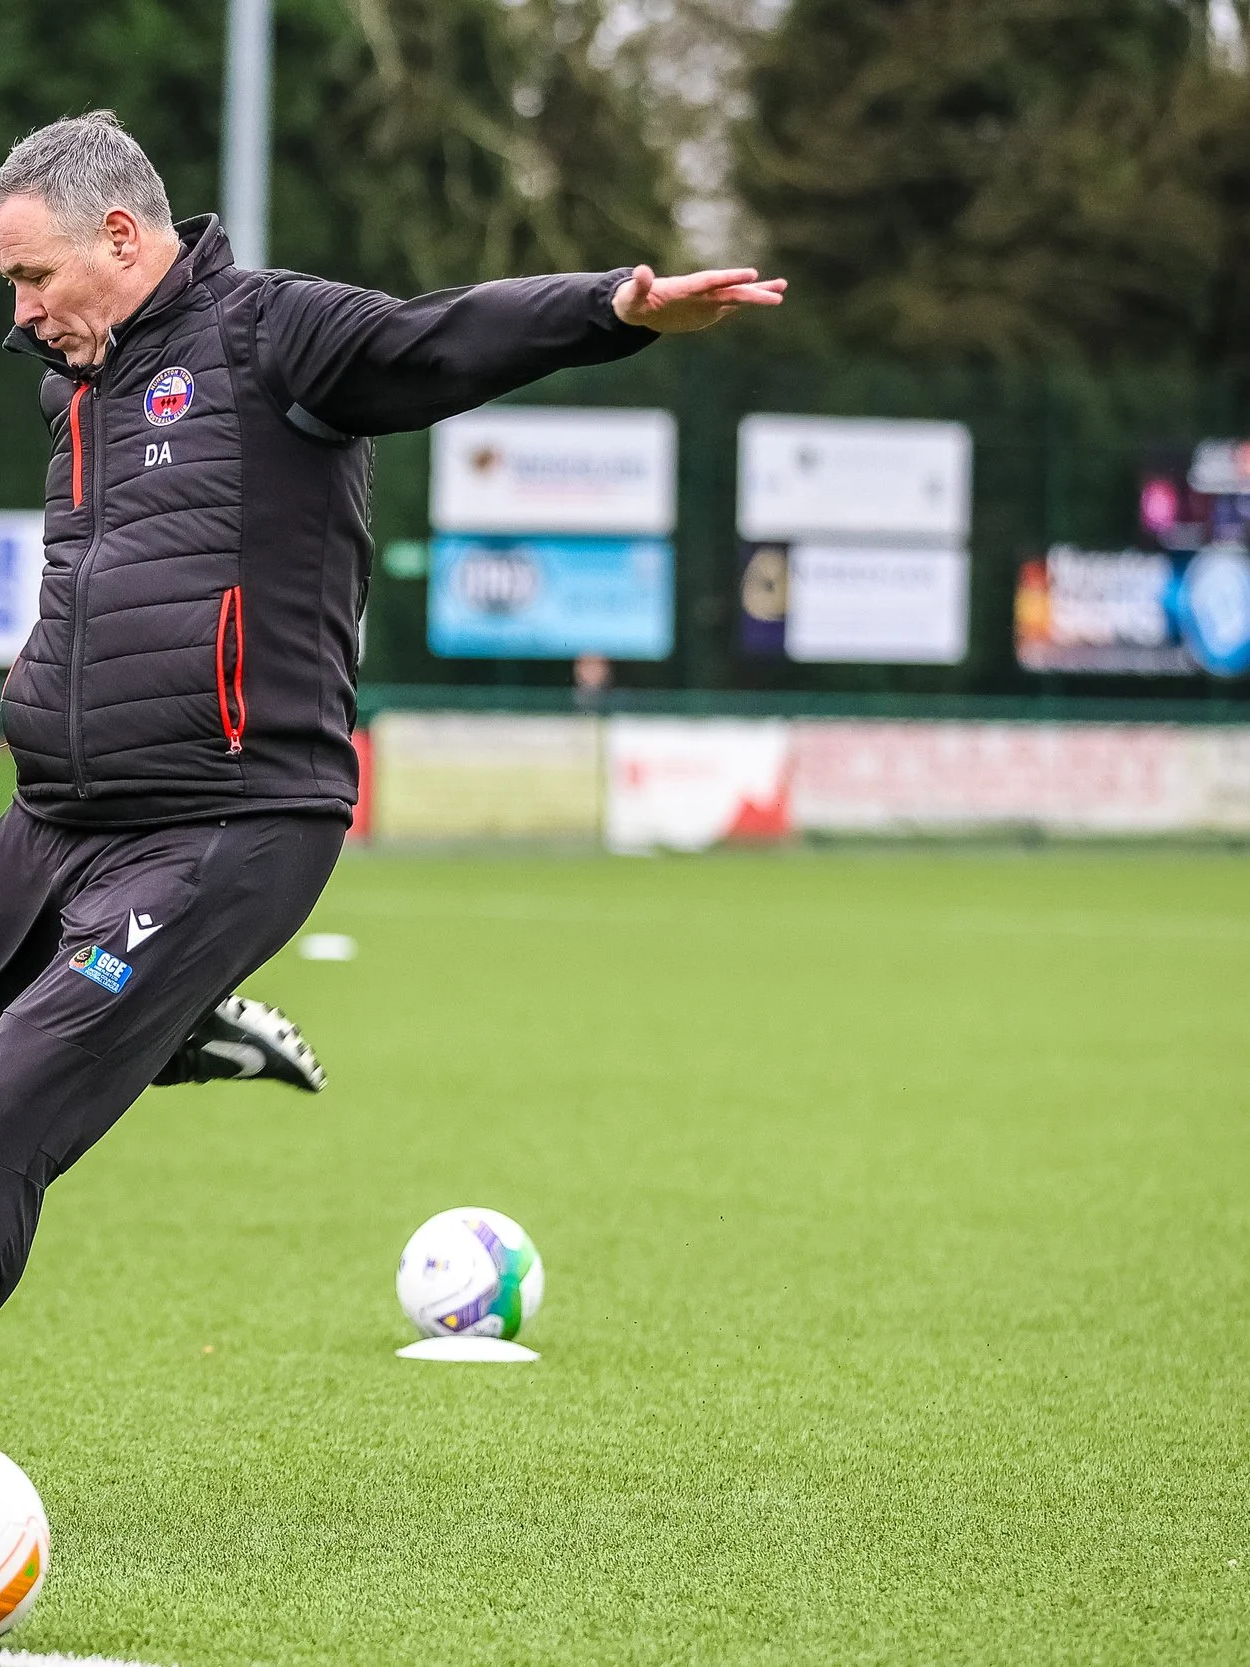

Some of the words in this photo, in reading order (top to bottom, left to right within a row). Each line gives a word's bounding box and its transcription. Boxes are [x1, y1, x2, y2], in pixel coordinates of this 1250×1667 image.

[150, 369, 178, 390] NUNEATON
[180, 370, 191, 385] TOWN
[144, 441, 173, 467] DA
[97, 952, 127, 978] GCE
